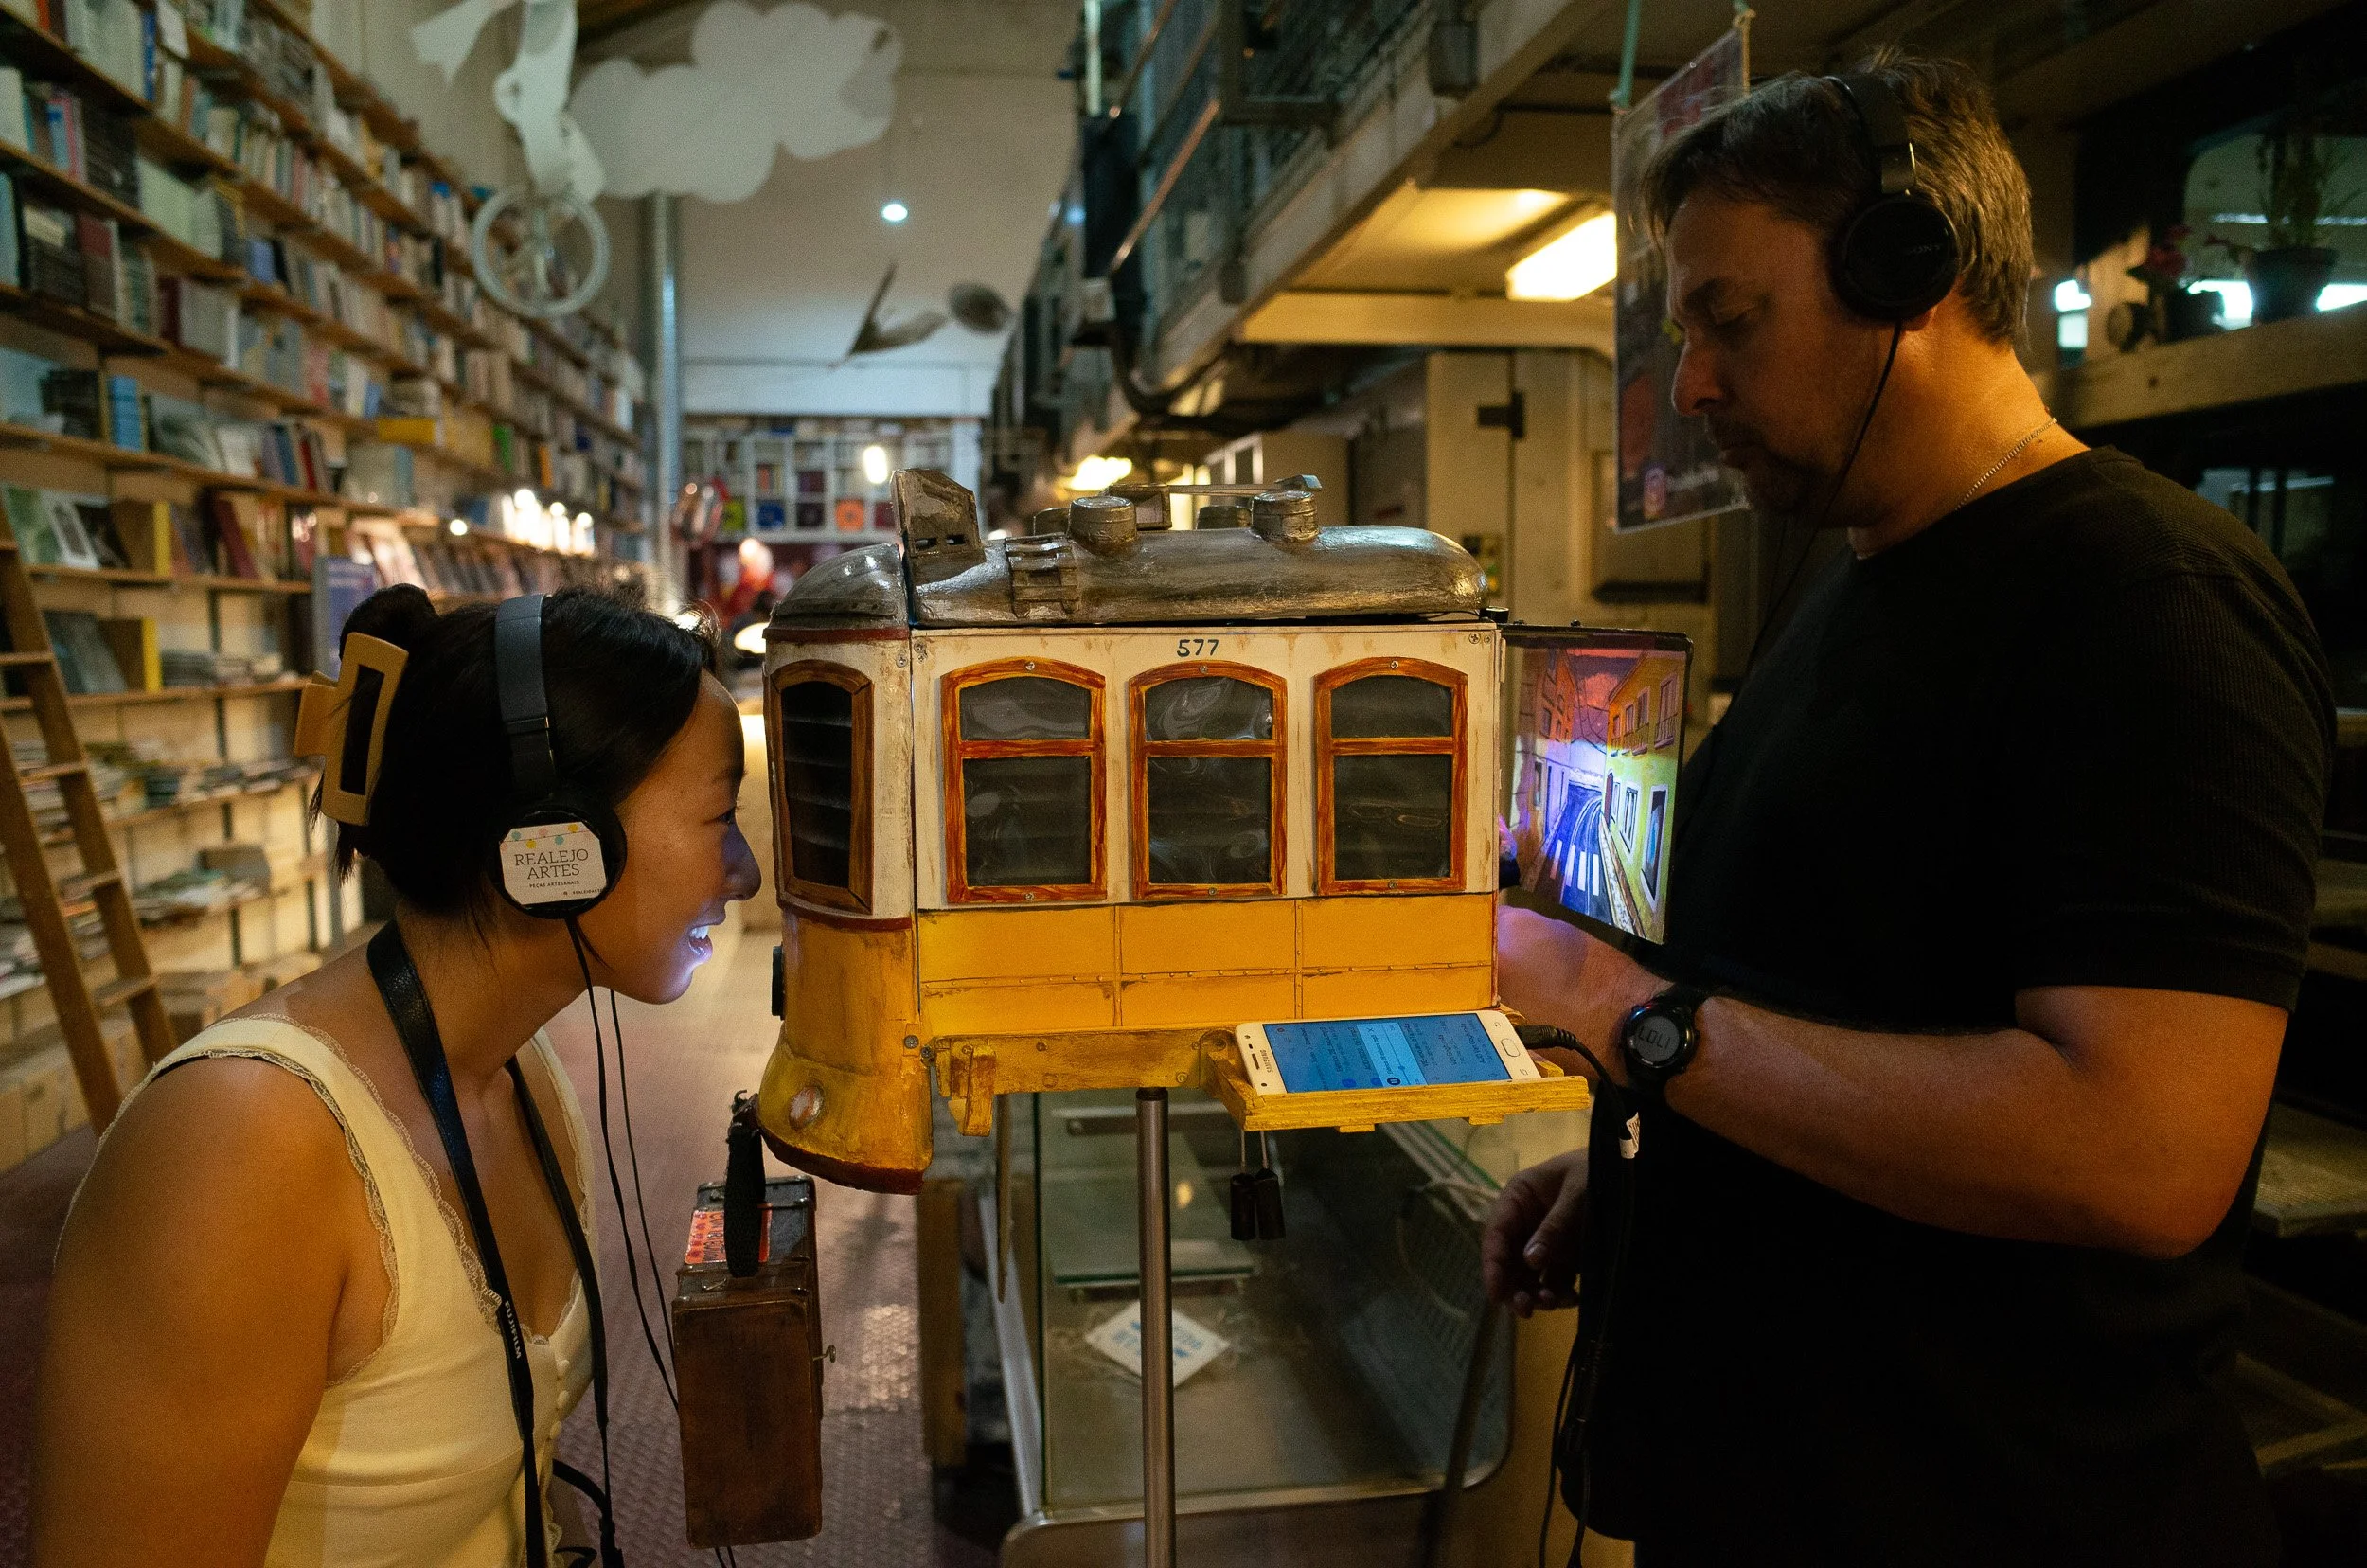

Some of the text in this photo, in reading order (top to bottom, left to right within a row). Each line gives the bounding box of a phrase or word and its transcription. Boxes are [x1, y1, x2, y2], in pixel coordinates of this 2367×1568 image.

[1176, 638, 1219, 657] 577
[514, 848, 589, 866] REALEJO
[526, 864, 580, 880] ARTES
[1259, 1049, 1273, 1073] SAMSUNG
[505, 1301, 522, 1359] FUJIFILM
